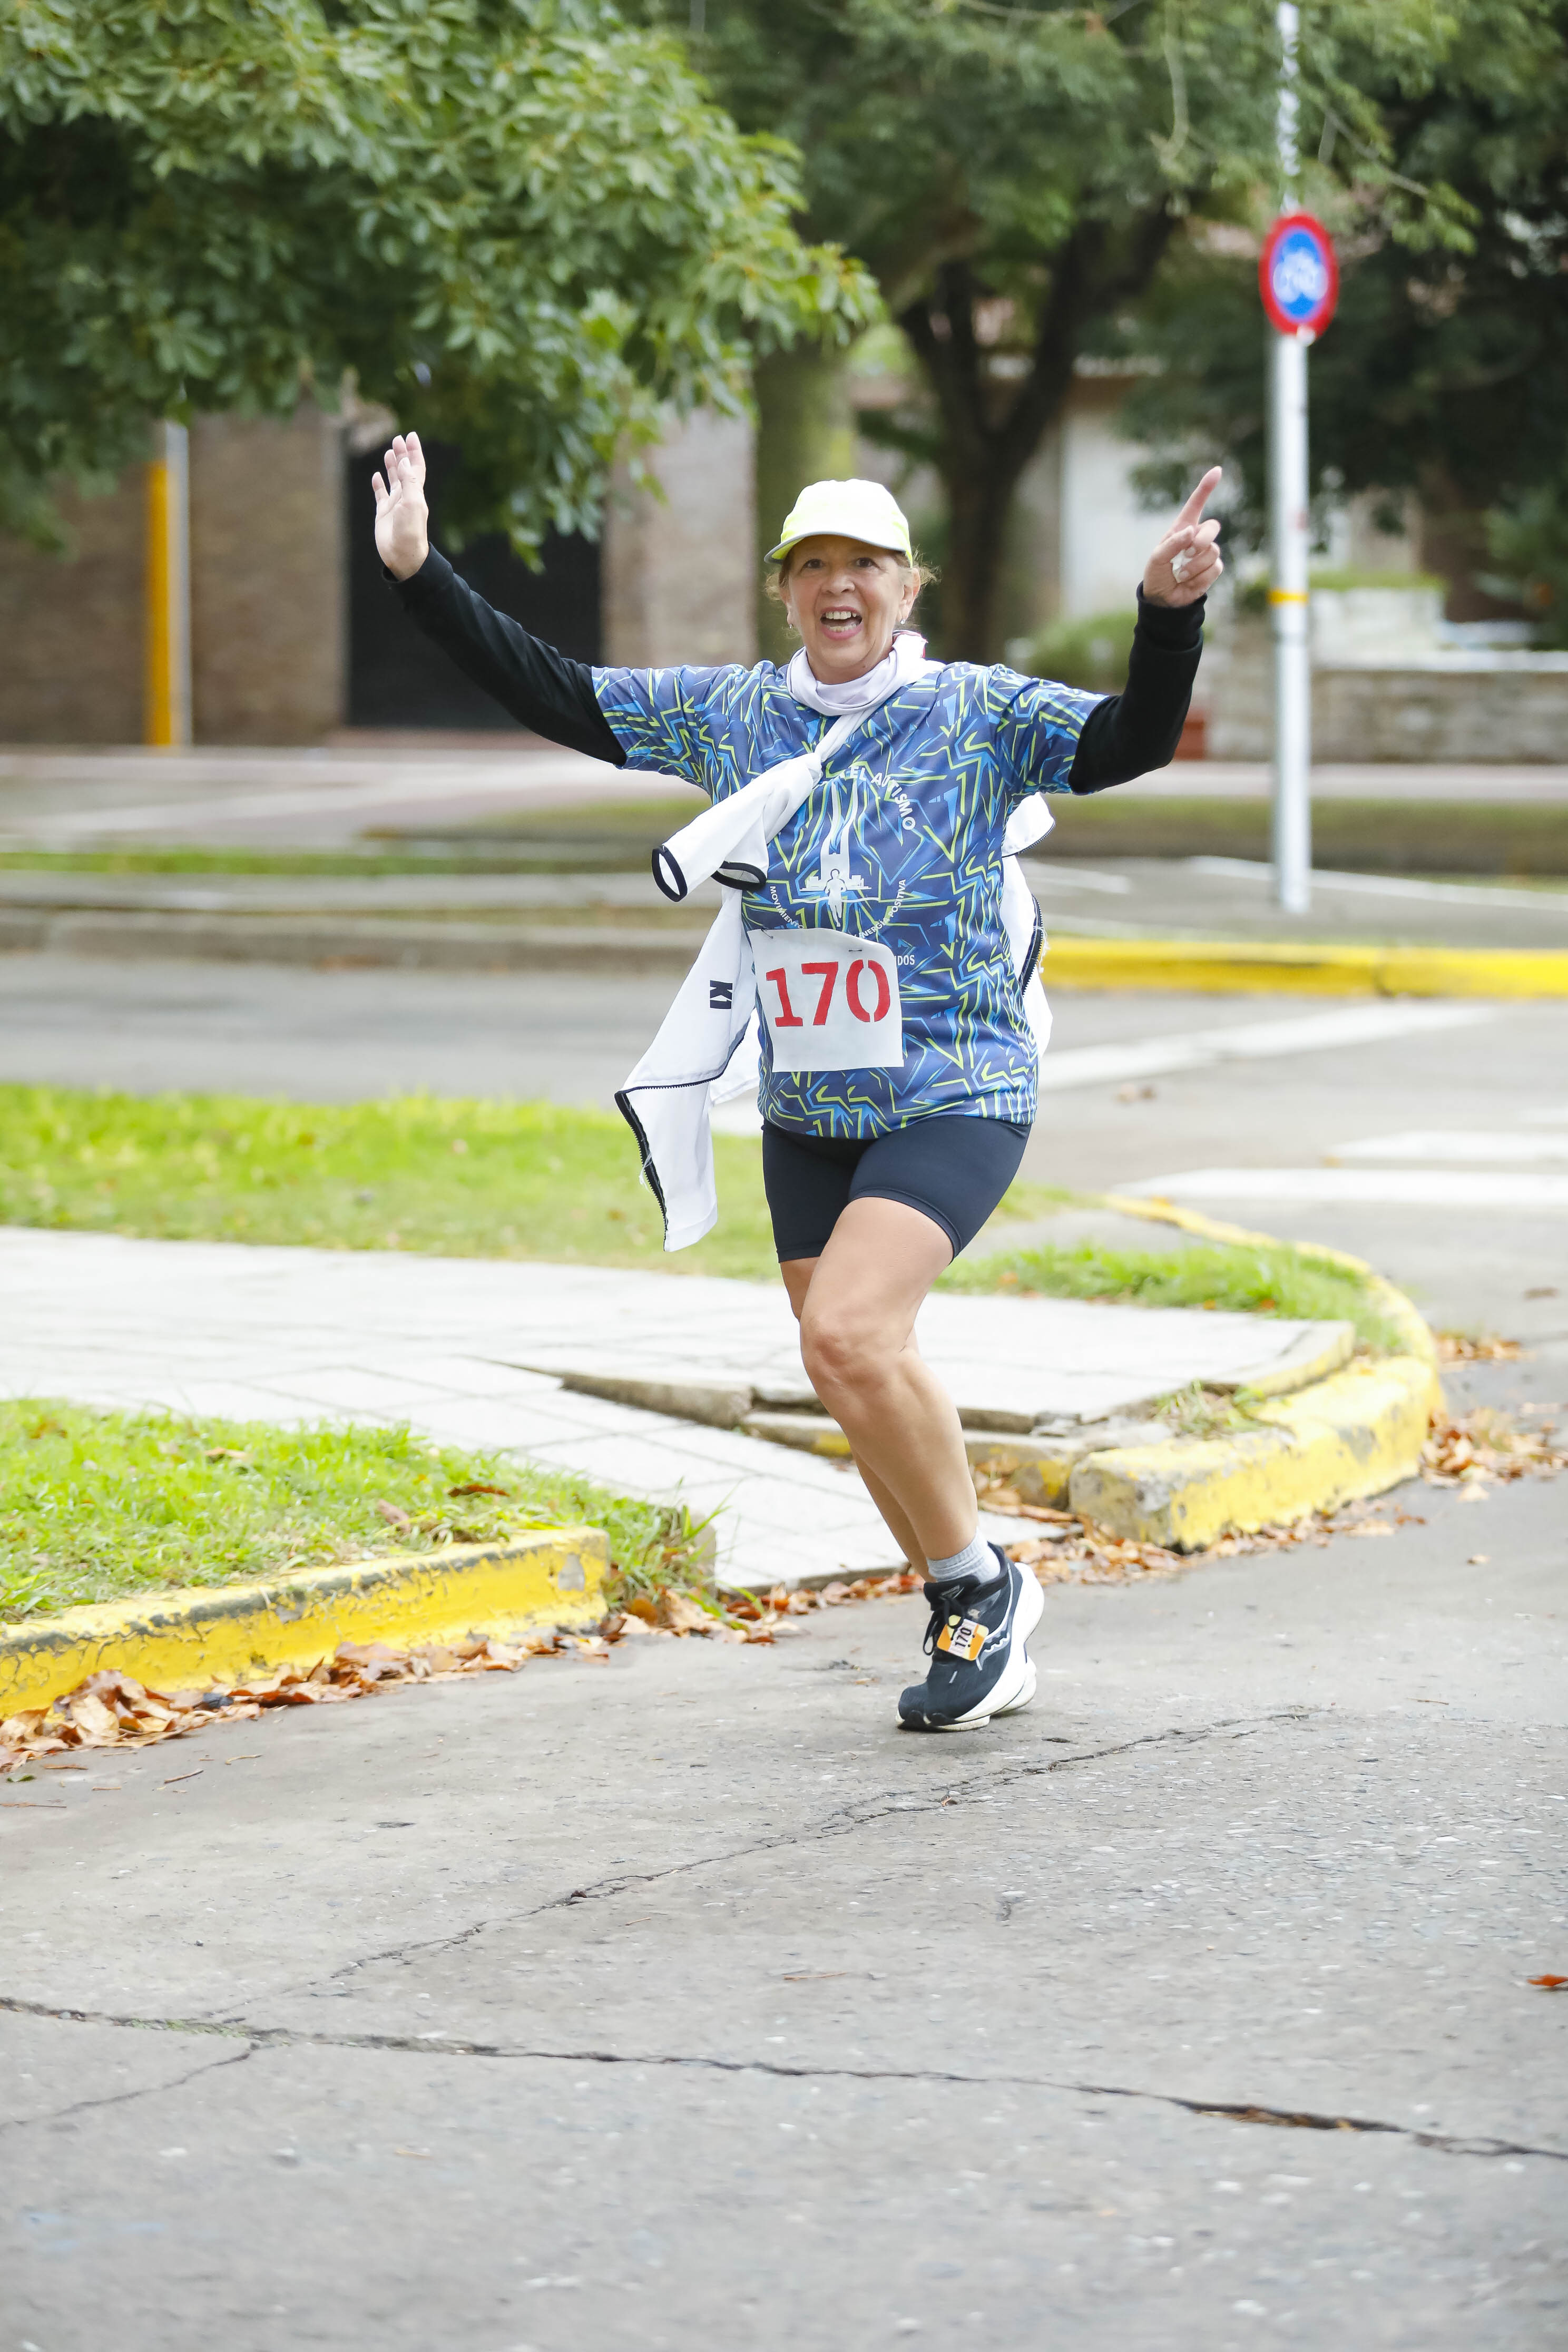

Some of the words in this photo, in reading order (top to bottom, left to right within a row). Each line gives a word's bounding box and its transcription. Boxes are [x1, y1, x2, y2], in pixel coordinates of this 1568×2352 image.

[870, 772, 916, 830] AUTISMO
[770, 886, 804, 929] MOVIMIENTO
[888, 879, 906, 918] POSITIVA
[710, 980, 733, 1010] K1
[766, 959, 890, 1027] 170
[955, 1627, 972, 1648] 170
